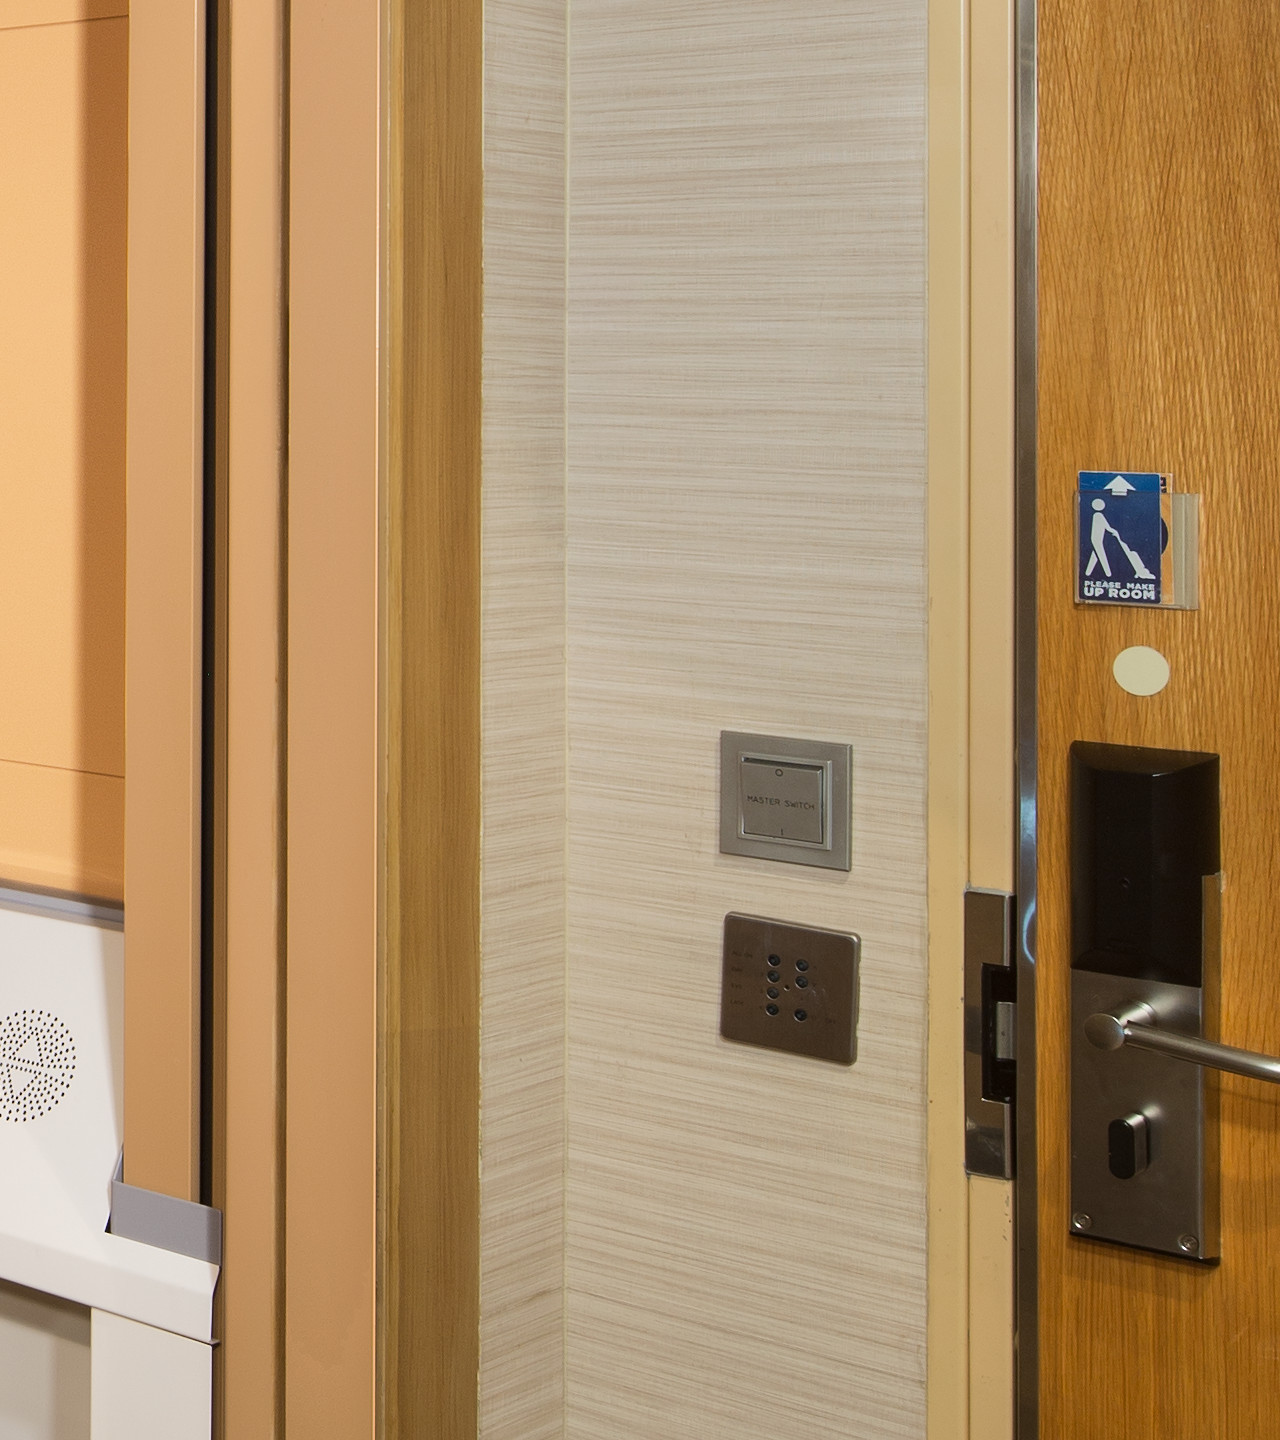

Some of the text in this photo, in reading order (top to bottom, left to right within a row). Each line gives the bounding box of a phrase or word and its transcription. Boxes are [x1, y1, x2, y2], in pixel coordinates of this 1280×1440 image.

[1084, 580, 1155, 591] PLEASE MAKE
[1083, 587, 1156, 600] UP ROOM
[747, 795, 815, 811] MASTER SWITCH
